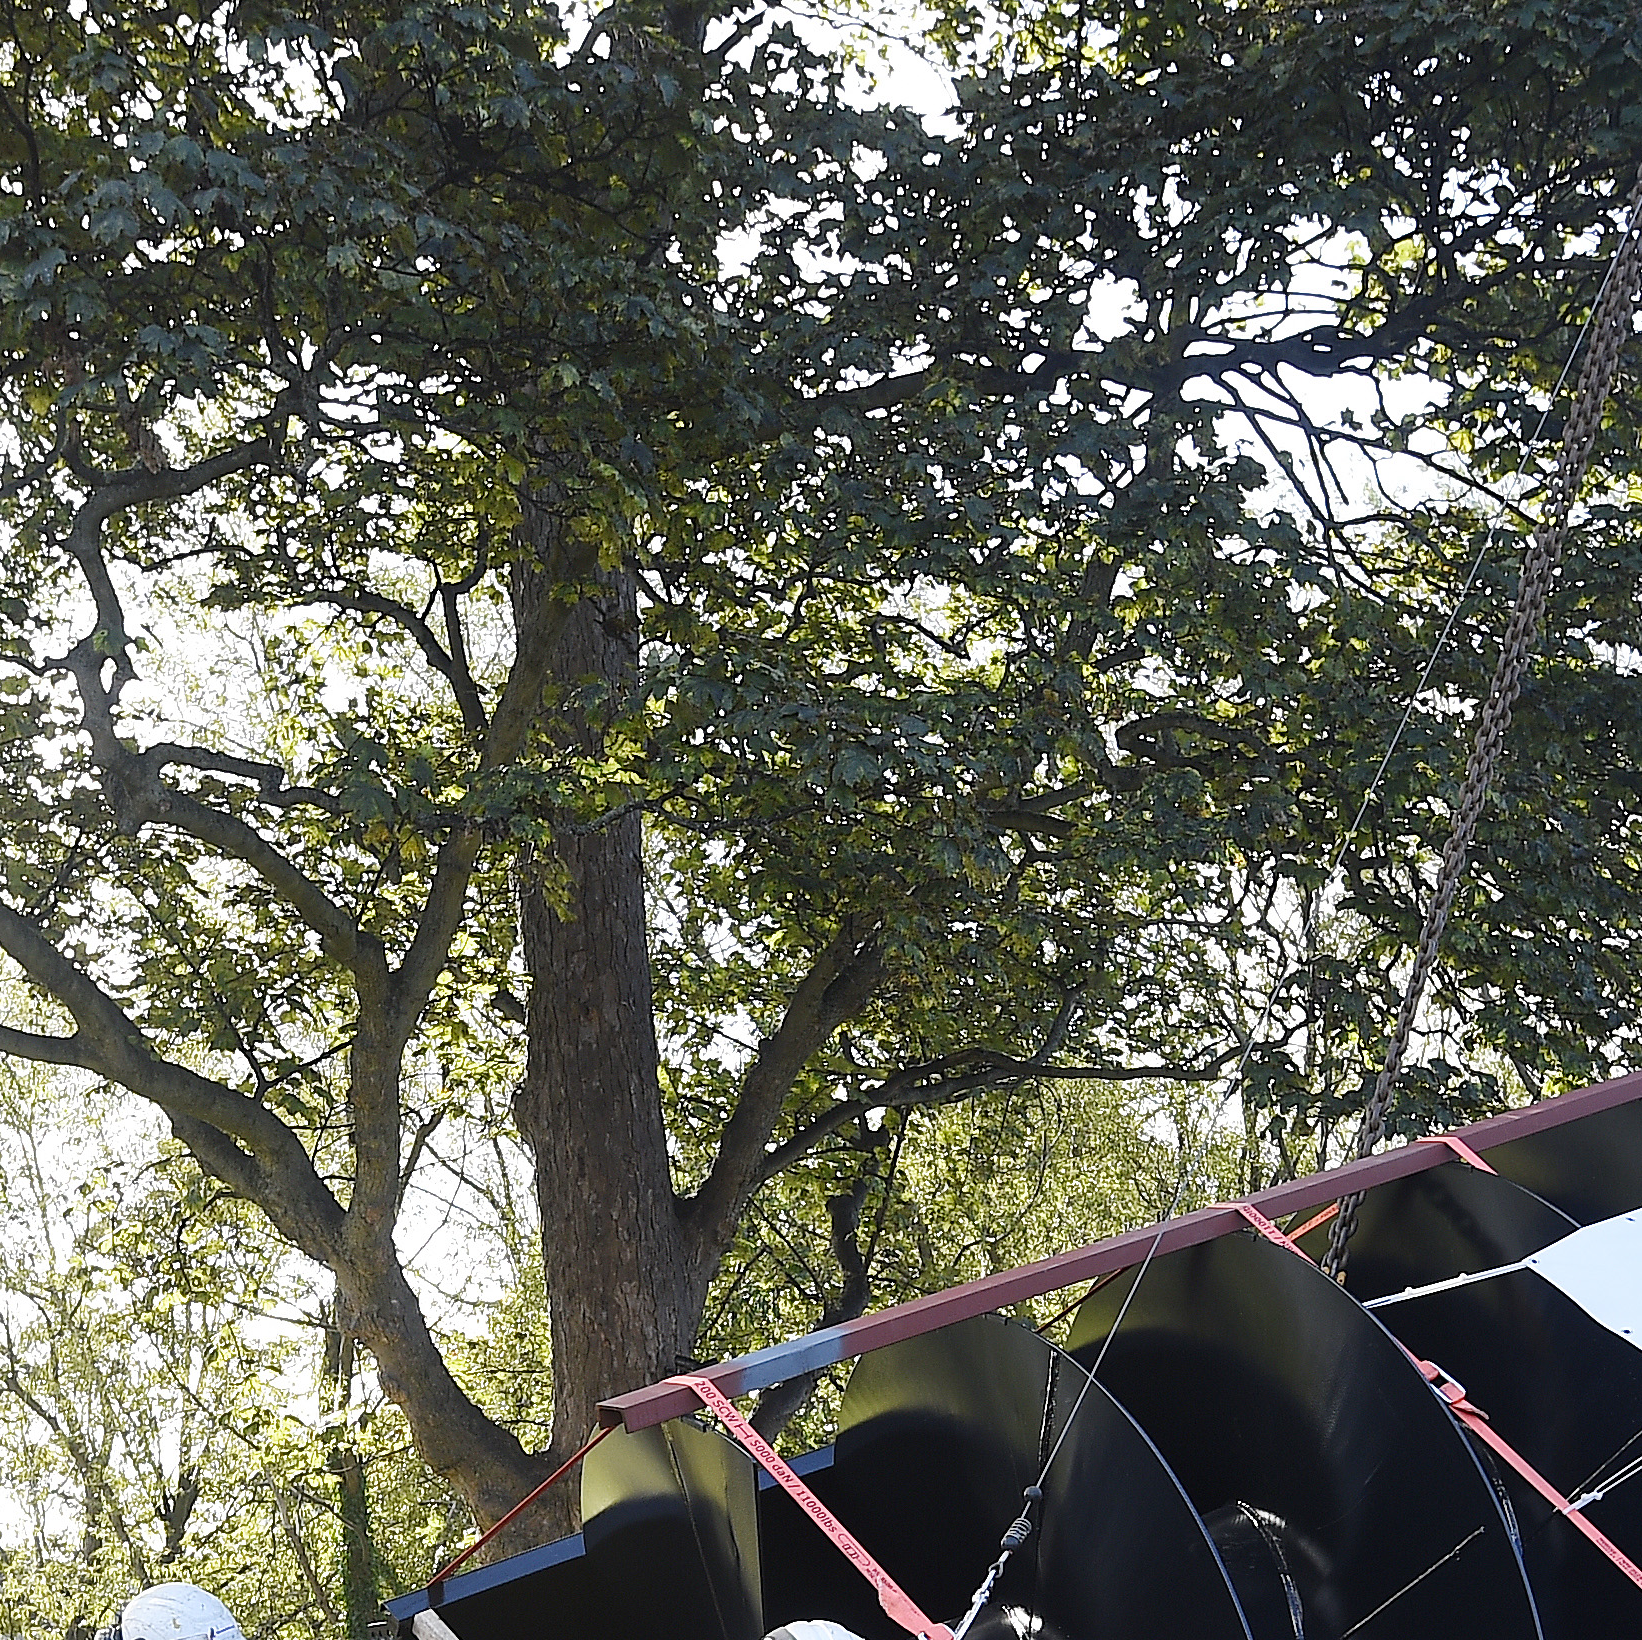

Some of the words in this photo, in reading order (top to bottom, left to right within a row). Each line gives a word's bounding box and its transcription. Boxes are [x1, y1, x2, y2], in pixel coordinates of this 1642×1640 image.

[695, 1381, 716, 1400] 200
[713, 1399, 739, 1424] SCW
[750, 1440, 775, 1463] 5000
[772, 1463, 794, 1483] daN
[796, 1490, 837, 1533] 11000lbs
